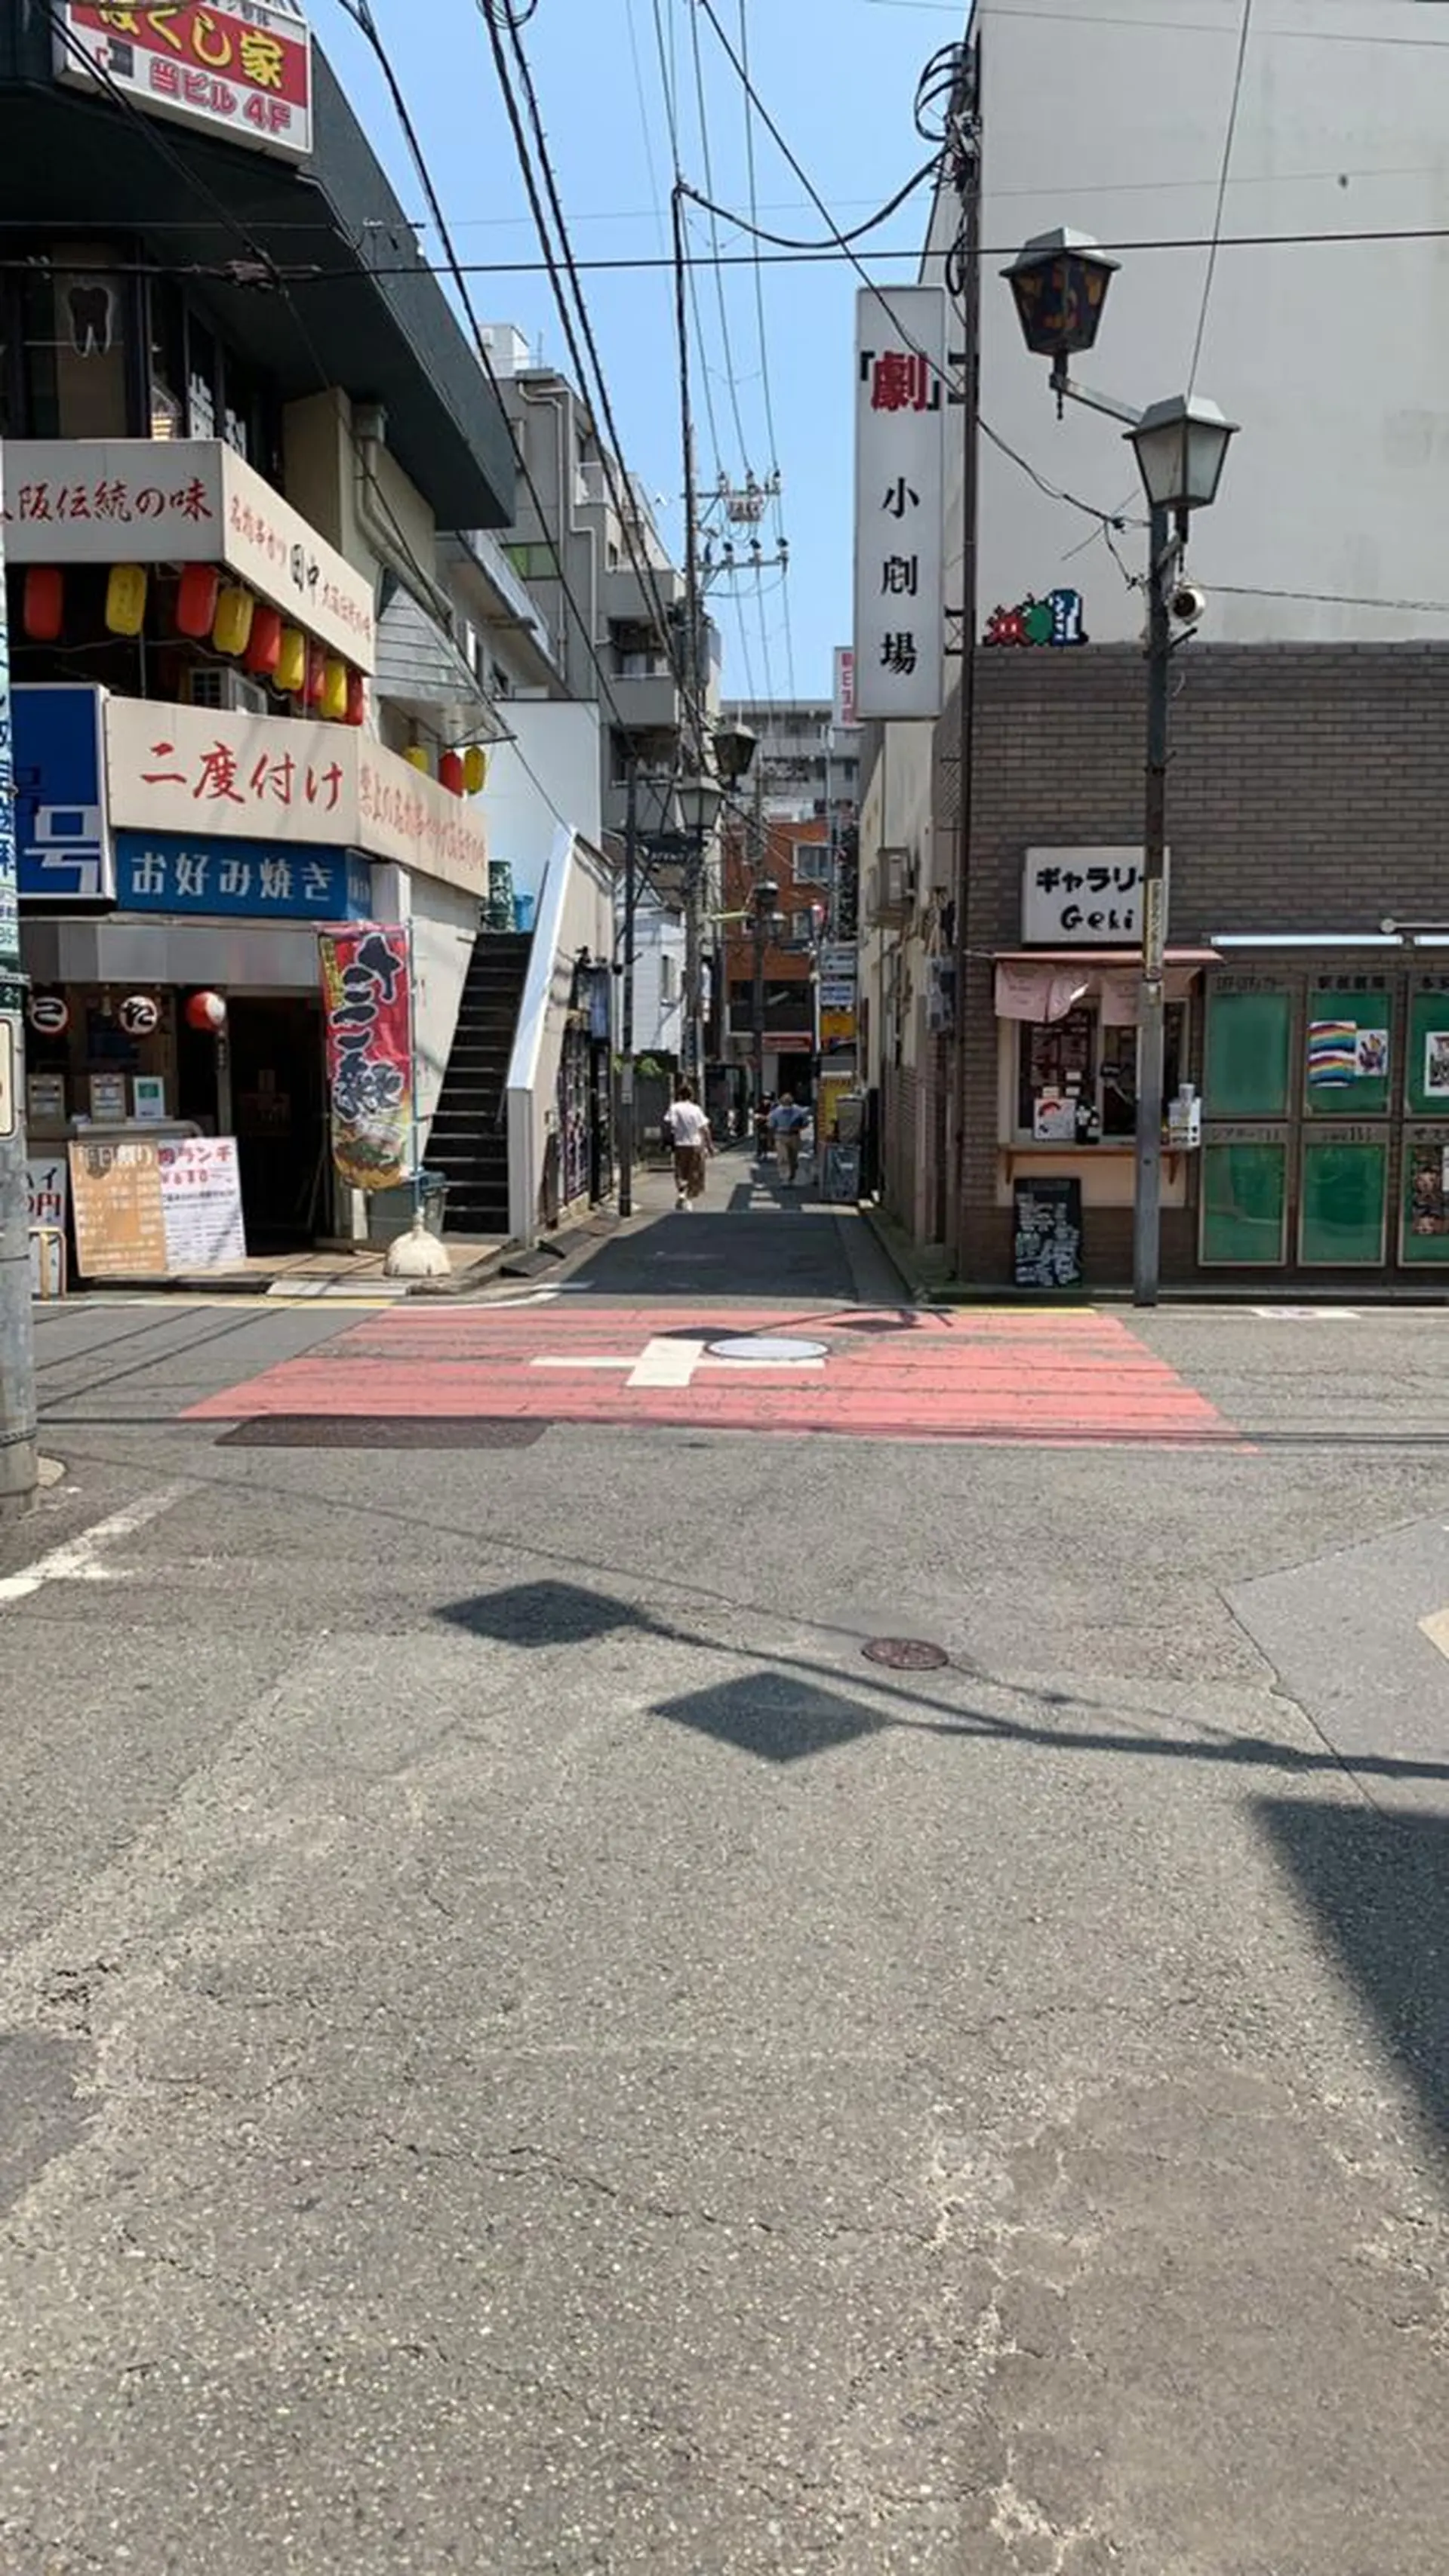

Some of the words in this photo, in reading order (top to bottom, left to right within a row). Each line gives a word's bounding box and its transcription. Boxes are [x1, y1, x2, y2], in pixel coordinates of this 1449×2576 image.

[139, 740, 344, 812] 二度付け
[131, 851, 335, 901] お好み焼き
[1036, 867, 1144, 894] ギャラリ
[1060, 906, 1134, 931] Geki
